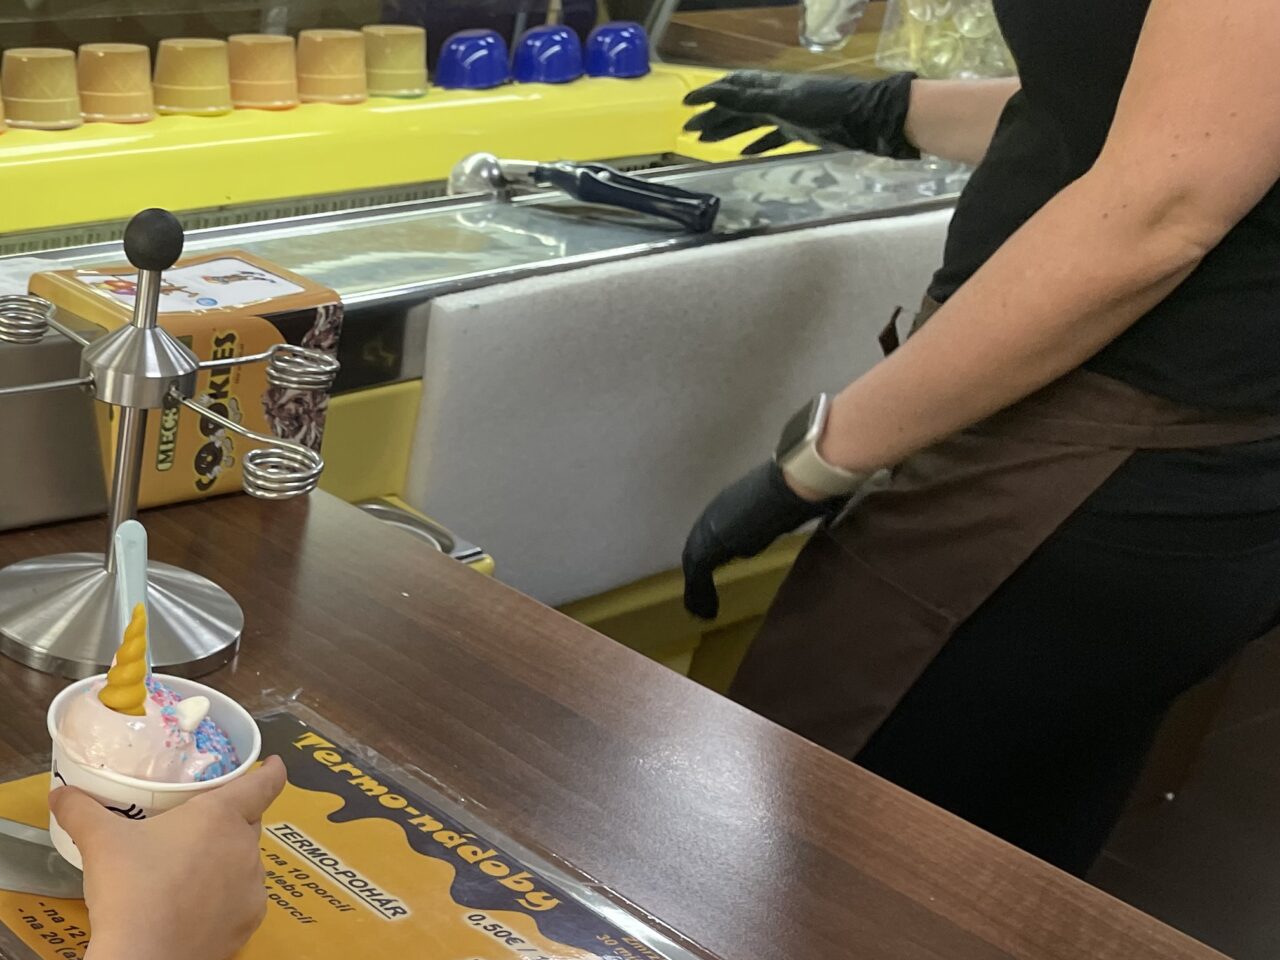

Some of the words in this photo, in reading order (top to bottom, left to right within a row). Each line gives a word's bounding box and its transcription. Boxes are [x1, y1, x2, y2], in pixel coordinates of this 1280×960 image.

[291, 731, 562, 912] Termo-nádoby
[265, 853, 289, 867] na
[287, 867, 311, 880] 10
[301, 881, 357, 912] porcií
[273, 823, 408, 918] TERMO-POHÁR
[22, 914, 45, 930] na
[40, 931, 66, 946] 20
[43, 908, 66, 924] na
[63, 924, 87, 939] 12
[467, 913, 526, 946] 0,50€
